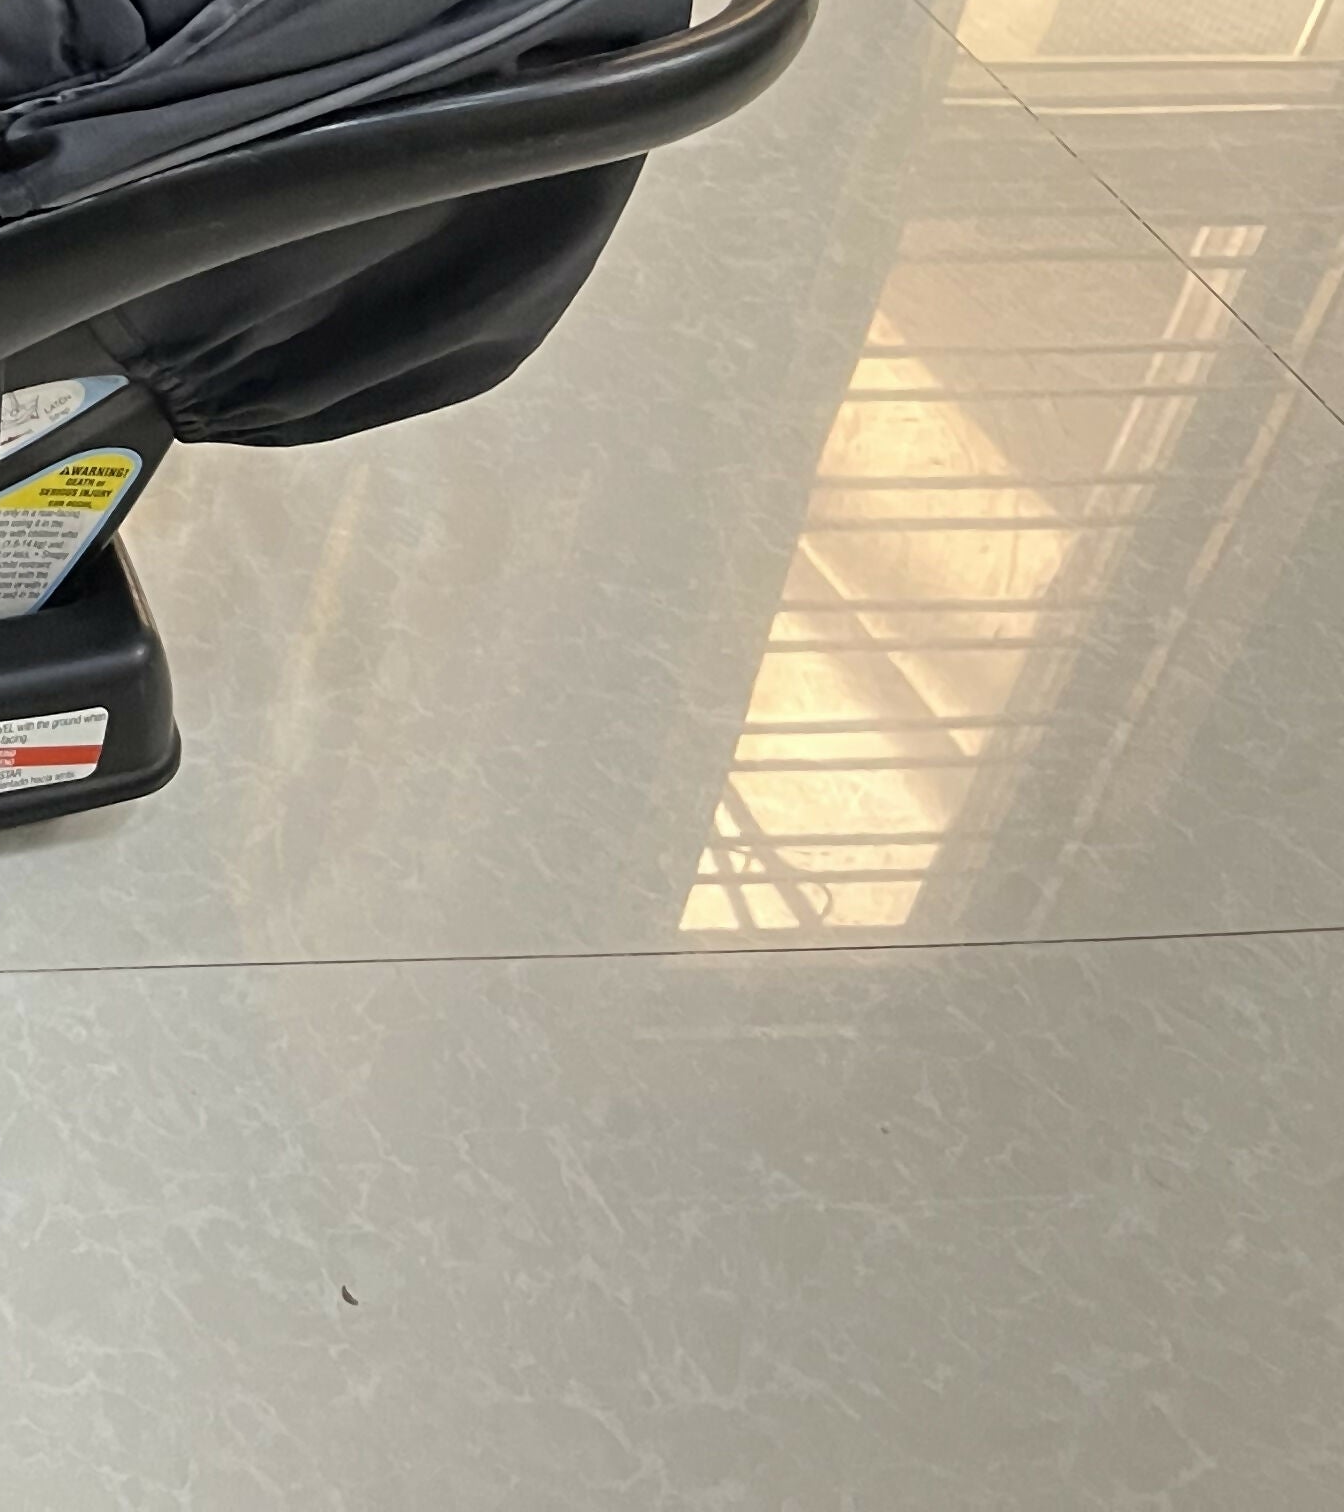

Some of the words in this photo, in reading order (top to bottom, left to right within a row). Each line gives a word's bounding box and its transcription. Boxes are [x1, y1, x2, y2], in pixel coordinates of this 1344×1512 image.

[71, 466, 130, 479] WARNING!
[35, 719, 50, 729] the
[51, 715, 82, 729] ground
